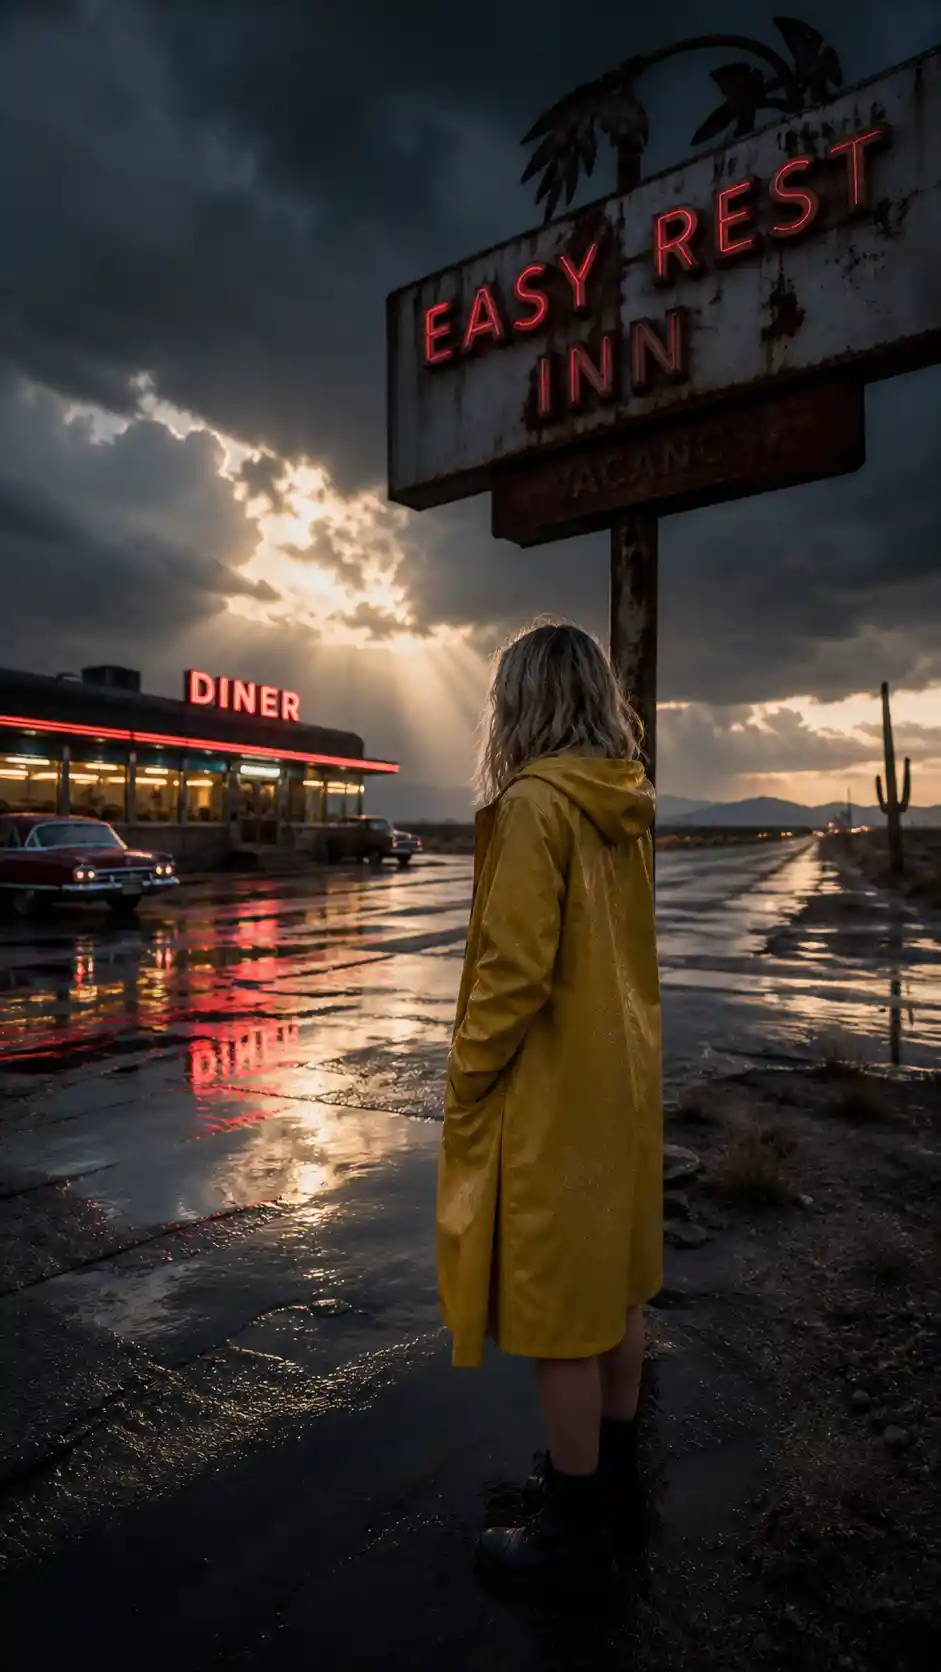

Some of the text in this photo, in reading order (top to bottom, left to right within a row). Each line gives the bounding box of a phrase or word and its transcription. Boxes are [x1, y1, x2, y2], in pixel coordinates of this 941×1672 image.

[423, 128, 887, 367] EASY REST
[538, 307, 685, 418] INN
[555, 418, 762, 499] VACANC
[187, 670, 300, 721] DINER
